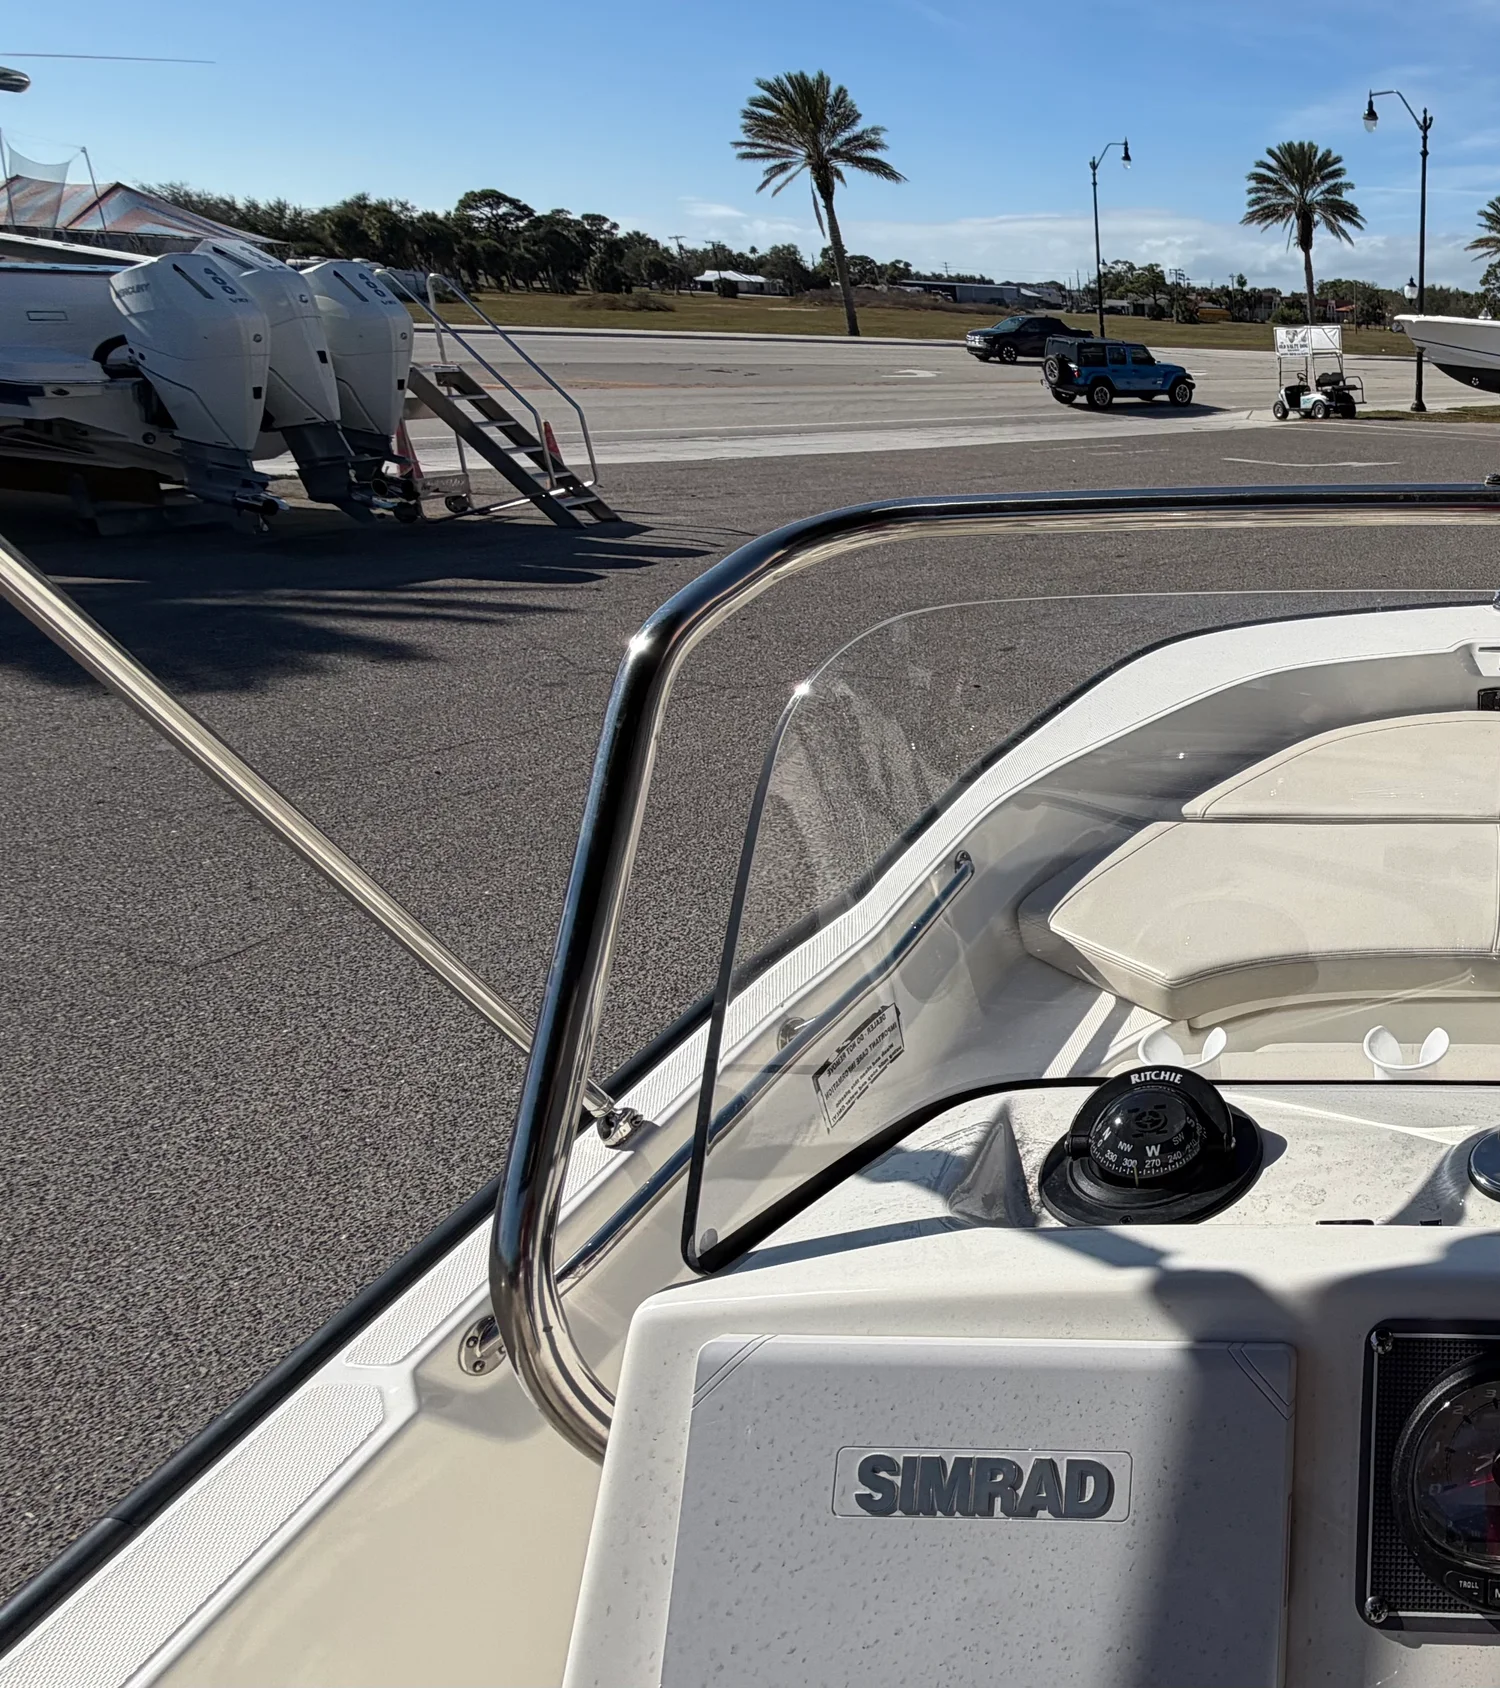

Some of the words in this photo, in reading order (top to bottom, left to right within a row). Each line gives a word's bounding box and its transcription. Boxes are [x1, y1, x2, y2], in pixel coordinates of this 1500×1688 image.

[204, 268, 237, 295] 400
[1130, 1070, 1183, 1085] RITCHIE
[1102, 1126, 1112, 1141] N
[1117, 1141, 1133, 1153] NW
[1145, 1144, 1161, 1157] W
[1172, 1131, 1185, 1146] SW
[1186, 1116, 1196, 1128] S
[1104, 1149, 1118, 1163] 330
[1122, 1157, 1138, 1168] 300
[1145, 1158, 1161, 1168] 270
[1167, 1150, 1182, 1164] 240
[1485, 1389, 1497, 1398] 3
[1452, 1405, 1464, 1415] 2
[854, 1453, 1115, 1519] SIMRAD
[1459, 1580, 1480, 1589] TROLL
